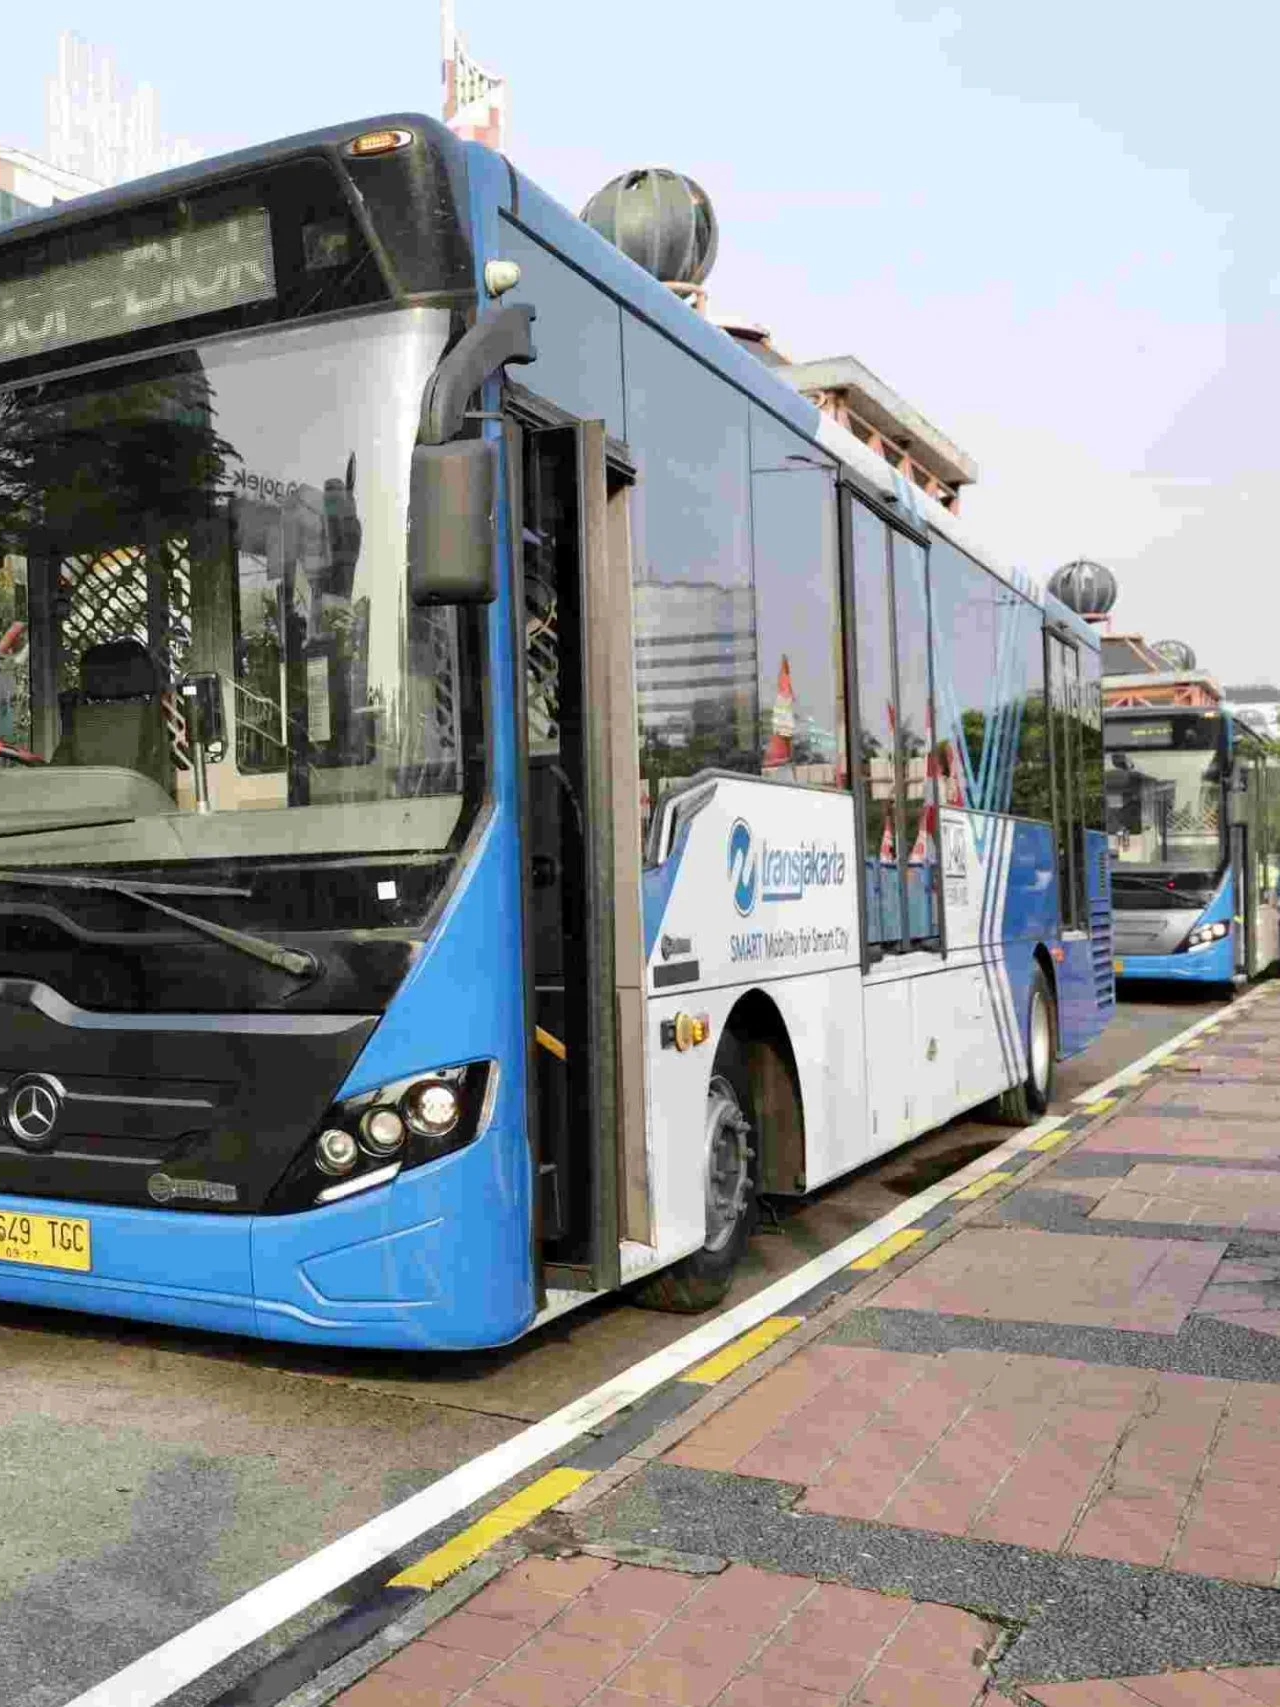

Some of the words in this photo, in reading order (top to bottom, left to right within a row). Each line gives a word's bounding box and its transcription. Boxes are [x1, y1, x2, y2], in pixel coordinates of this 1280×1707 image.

[762, 838, 845, 901] transjakarta
[730, 932, 762, 961] SMART
[764, 929, 797, 959] Mobility
[811, 926, 833, 952] Smart
[834, 926, 849, 955] City
[47, 1220, 84, 1252] TGC
